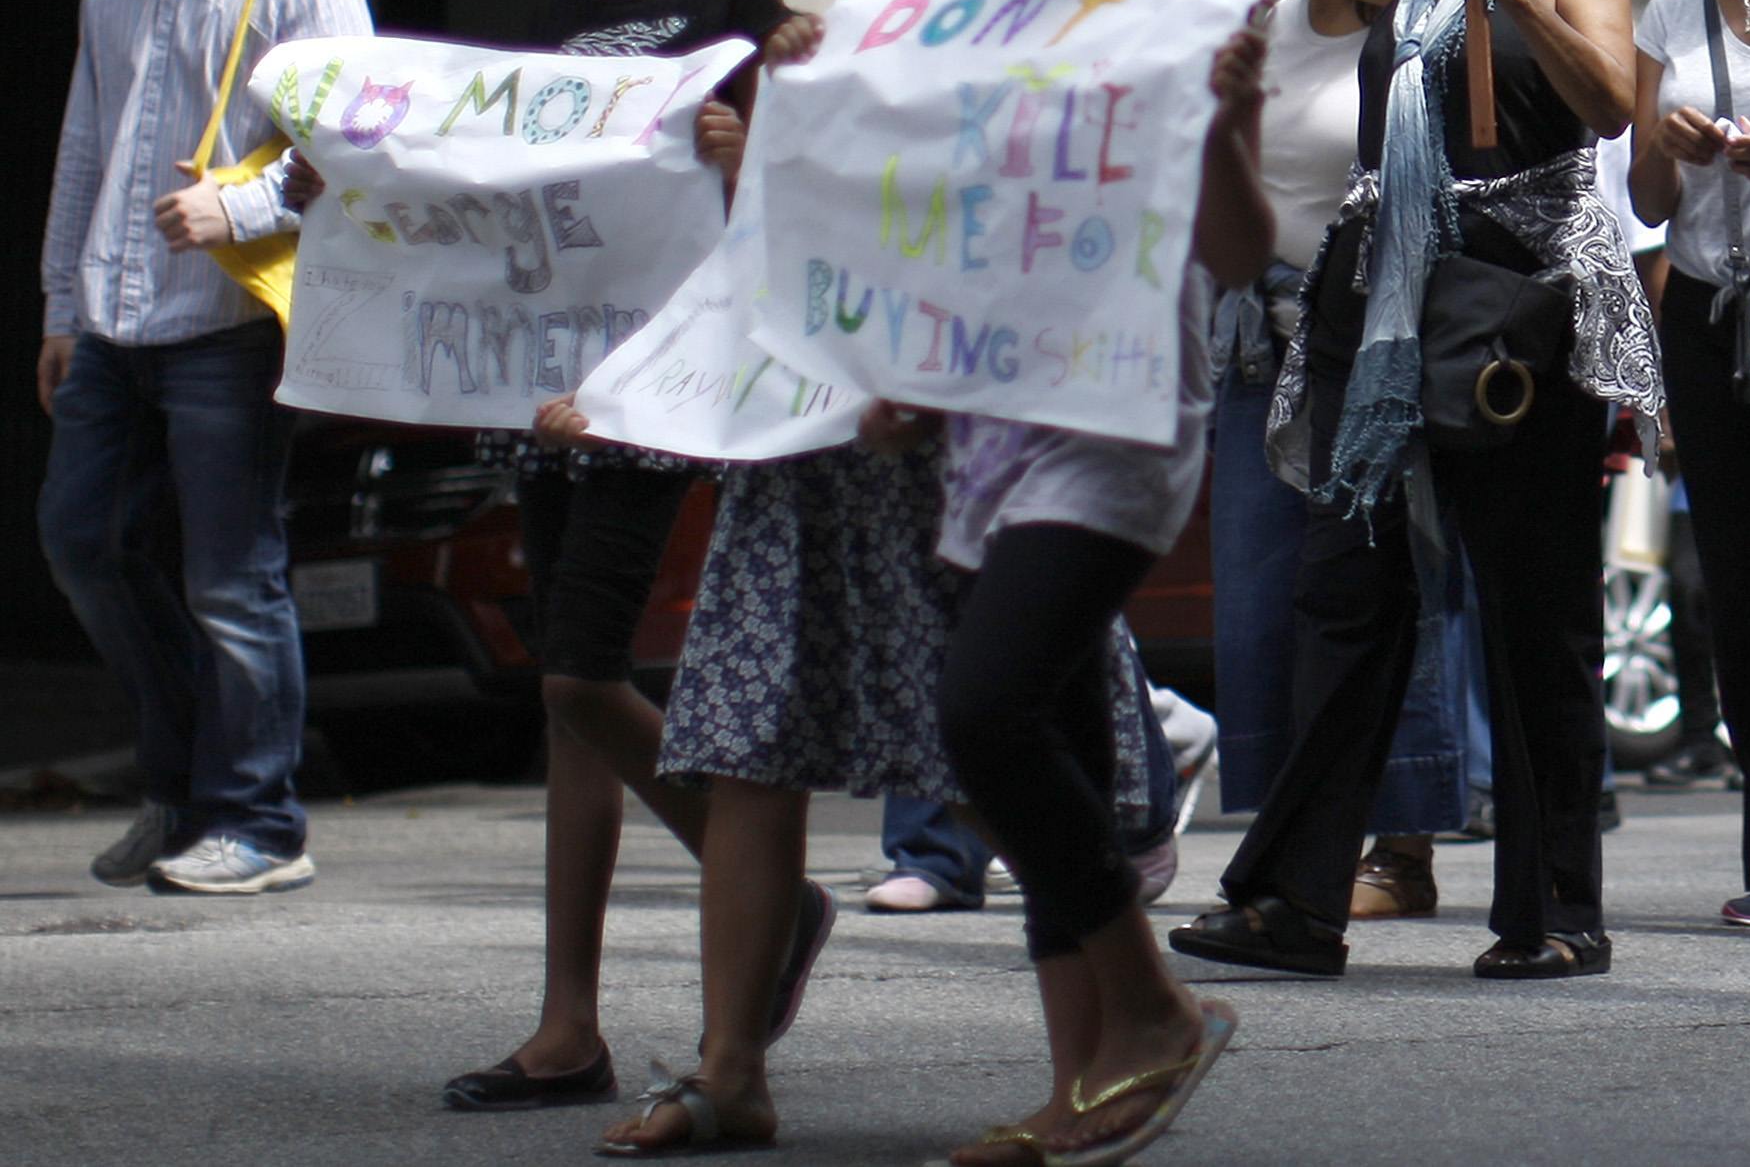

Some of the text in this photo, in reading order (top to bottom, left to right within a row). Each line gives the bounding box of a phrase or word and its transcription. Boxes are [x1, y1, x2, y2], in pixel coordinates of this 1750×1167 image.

[879, 154, 1165, 289] ME FOR
[805, 258, 1021, 383] BUYING
